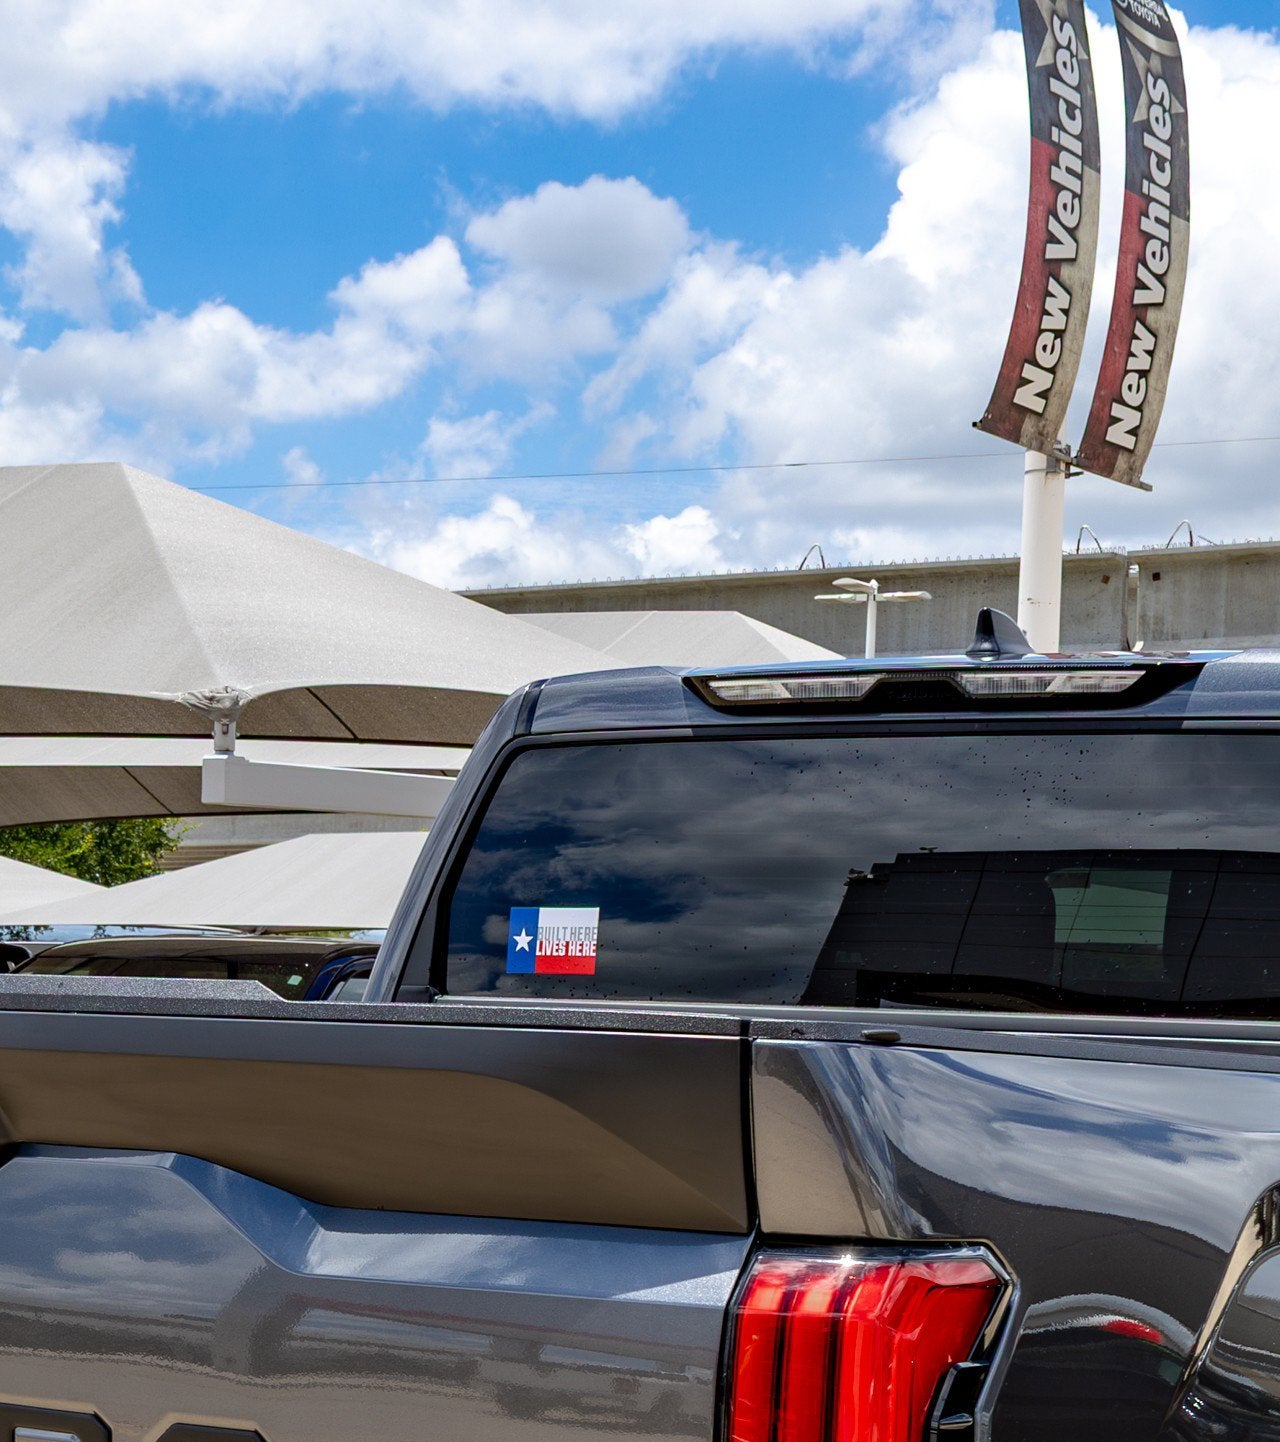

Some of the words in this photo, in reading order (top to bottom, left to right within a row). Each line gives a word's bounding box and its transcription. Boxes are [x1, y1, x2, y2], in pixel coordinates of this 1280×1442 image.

[1013, 276, 1071, 414] New
[1045, 13, 1083, 260] Vehicles
[1105, 320, 1156, 451] New
[1133, 72, 1173, 305] Vehicles
[536, 940, 566, 956] LIVES
[568, 941, 596, 956] HERE
[537, 926, 568, 941] BUILT
[570, 926, 597, 941] HERE
